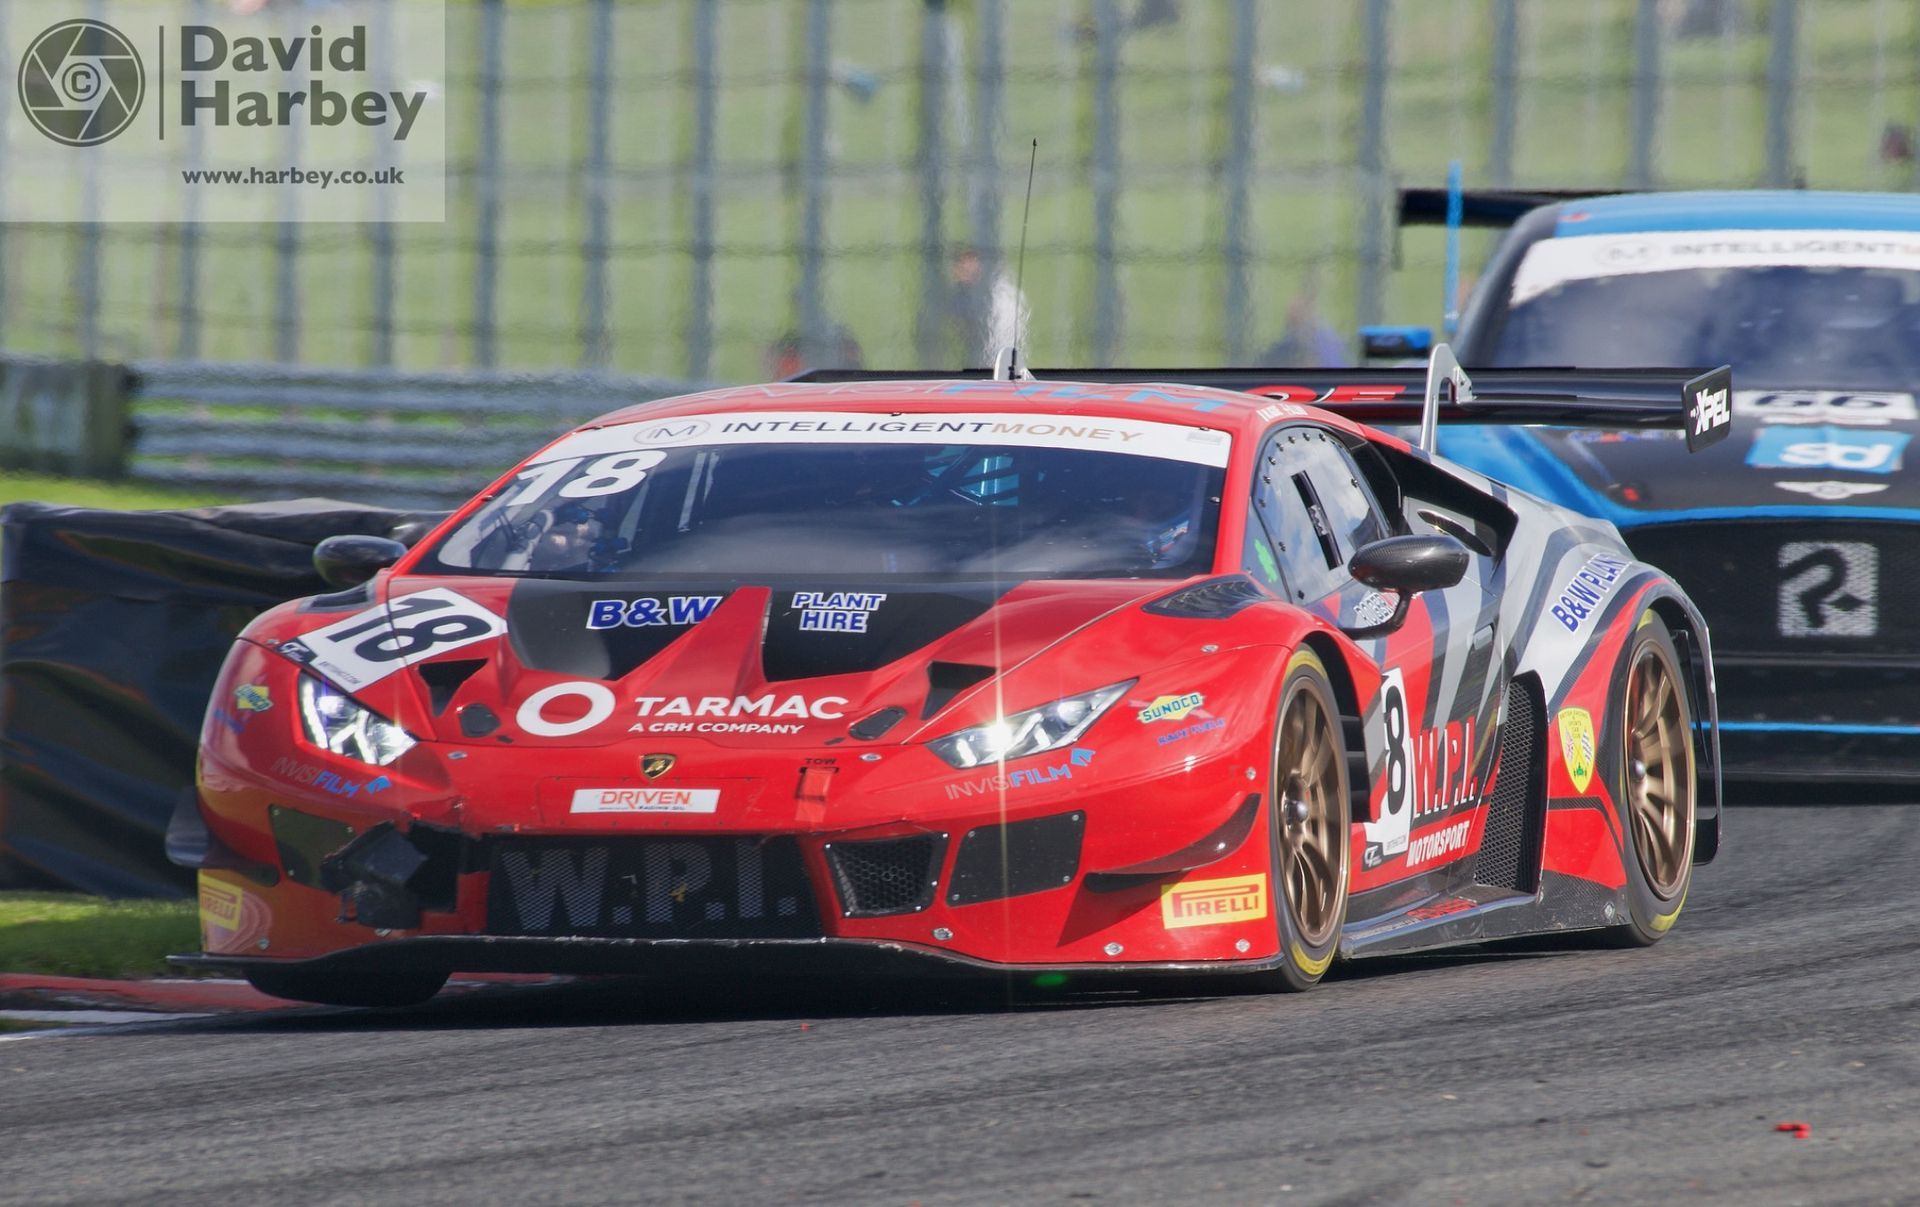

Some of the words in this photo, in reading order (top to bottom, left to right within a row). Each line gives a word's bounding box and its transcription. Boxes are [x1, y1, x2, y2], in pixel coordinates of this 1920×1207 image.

[1695, 388, 1730, 436] XPEL
[721, 420, 1144, 442] INTELLIGENTMONEY
[505, 449, 668, 506] 18
[587, 596, 722, 630] B&W
[791, 592, 887, 611] PLANT
[1550, 576, 1603, 633] B&W
[326, 597, 492, 662] 18
[799, 610, 869, 633] HIRE
[634, 694, 850, 719] TARMAC
[1141, 694, 1201, 722] SUNOCO
[628, 722, 645, 733] A
[648, 722, 696, 733] CRH
[697, 722, 805, 735] COMPANY
[600, 791, 692, 808] DRIVEN
[944, 764, 1073, 801] INVISIFILM
[1406, 820, 1470, 867] MOTORSPORT
[1171, 883, 1260, 919] PIRELLI
